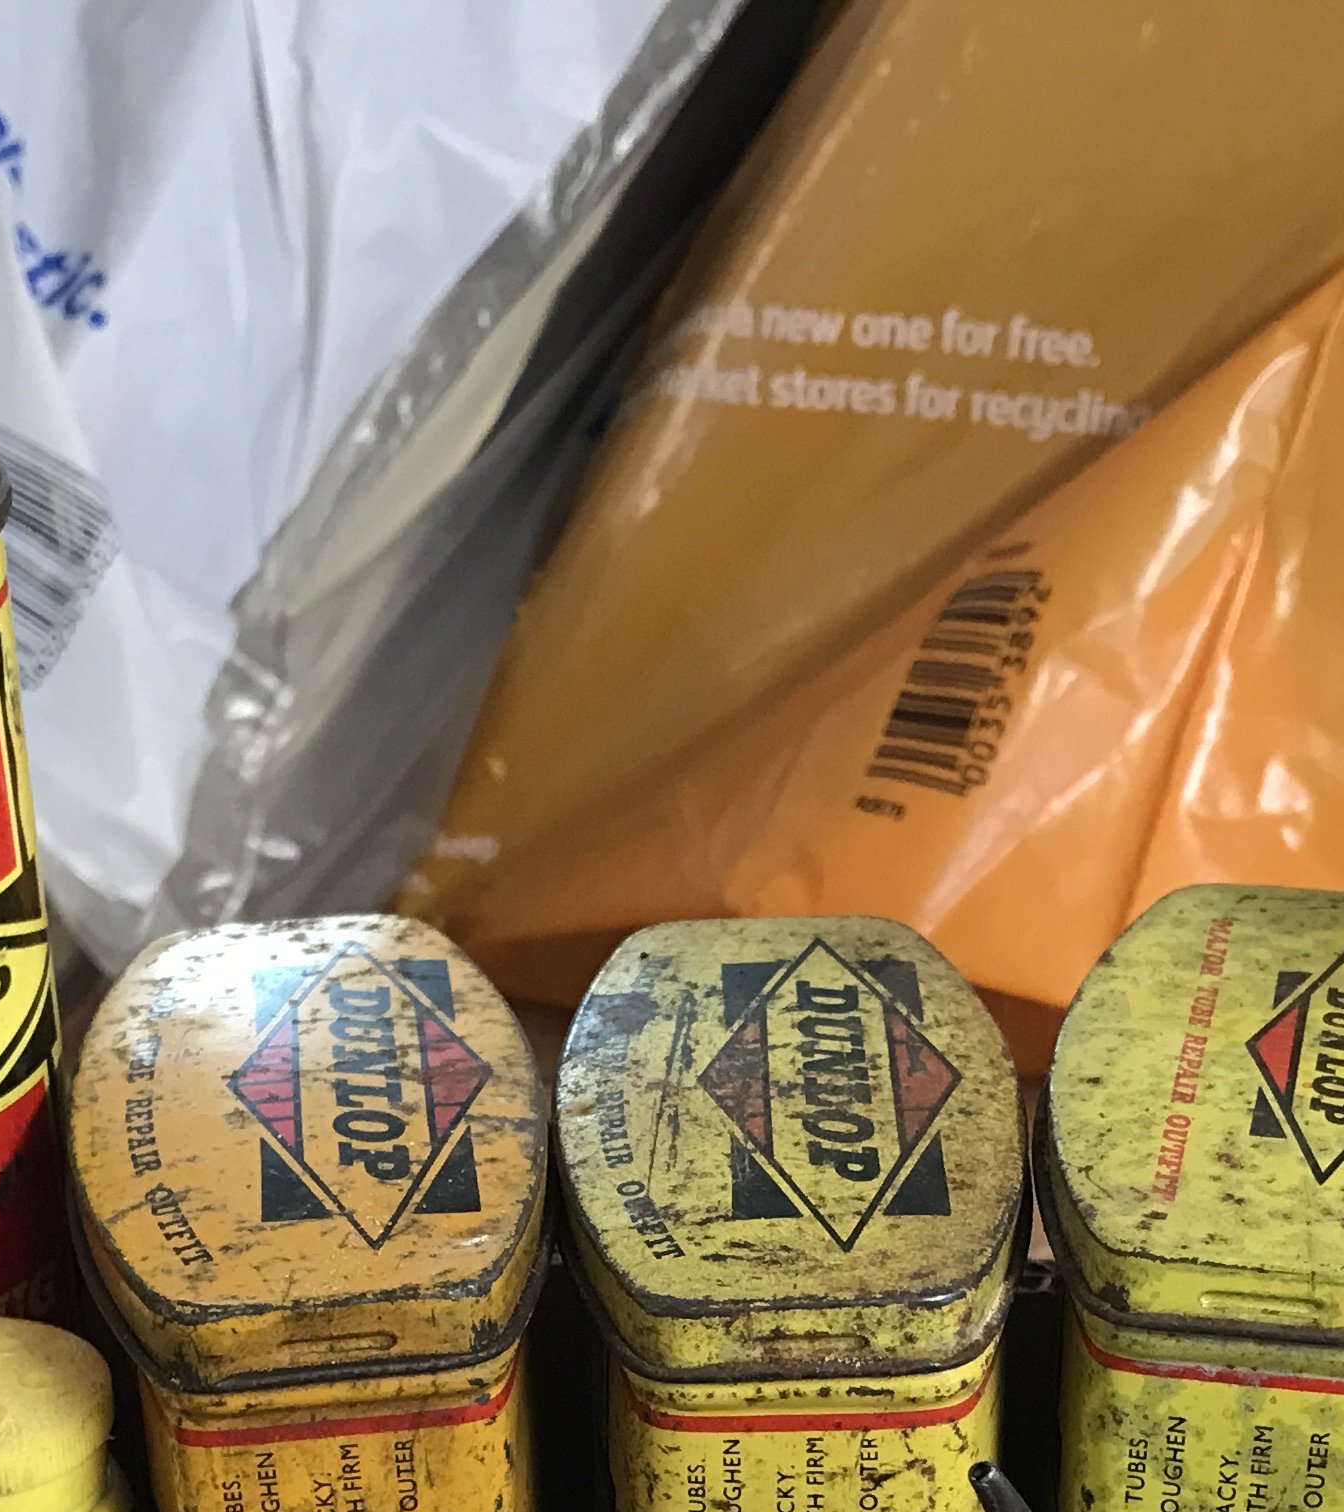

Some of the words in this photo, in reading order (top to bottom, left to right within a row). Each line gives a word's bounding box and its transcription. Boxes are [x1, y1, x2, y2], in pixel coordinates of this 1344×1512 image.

[761, 303, 843, 345] new
[851, 309, 934, 352] one
[941, 308, 997, 357] for
[1004, 314, 1101, 368] free.
[770, 370, 895, 416] stores
[904, 368, 960, 420] for
[1200, 917, 1234, 976] MAJOR
[1188, 980, 1221, 1029] TUBE
[329, 981, 412, 1182] DUNLOP
[796, 980, 881, 1182] DUNLOP
[1170, 1030, 1208, 1104] REPAIR
[595, 1089, 634, 1169] REPAIR
[1152, 1114, 1192, 1202] OUTFIT
[125, 1096, 163, 1175] REPAIR
[145, 1183, 214, 1267] OUTFIT
[339, 1444, 362, 1491] FIRM
[394, 1439, 418, 1512] OUTER
[806, 1436, 825, 1486] FIRM
[859, 1438, 878, 1510] OUTER
[1251, 1425, 1273, 1475] FIRM
[1304, 1432, 1330, 1509] OUTER
